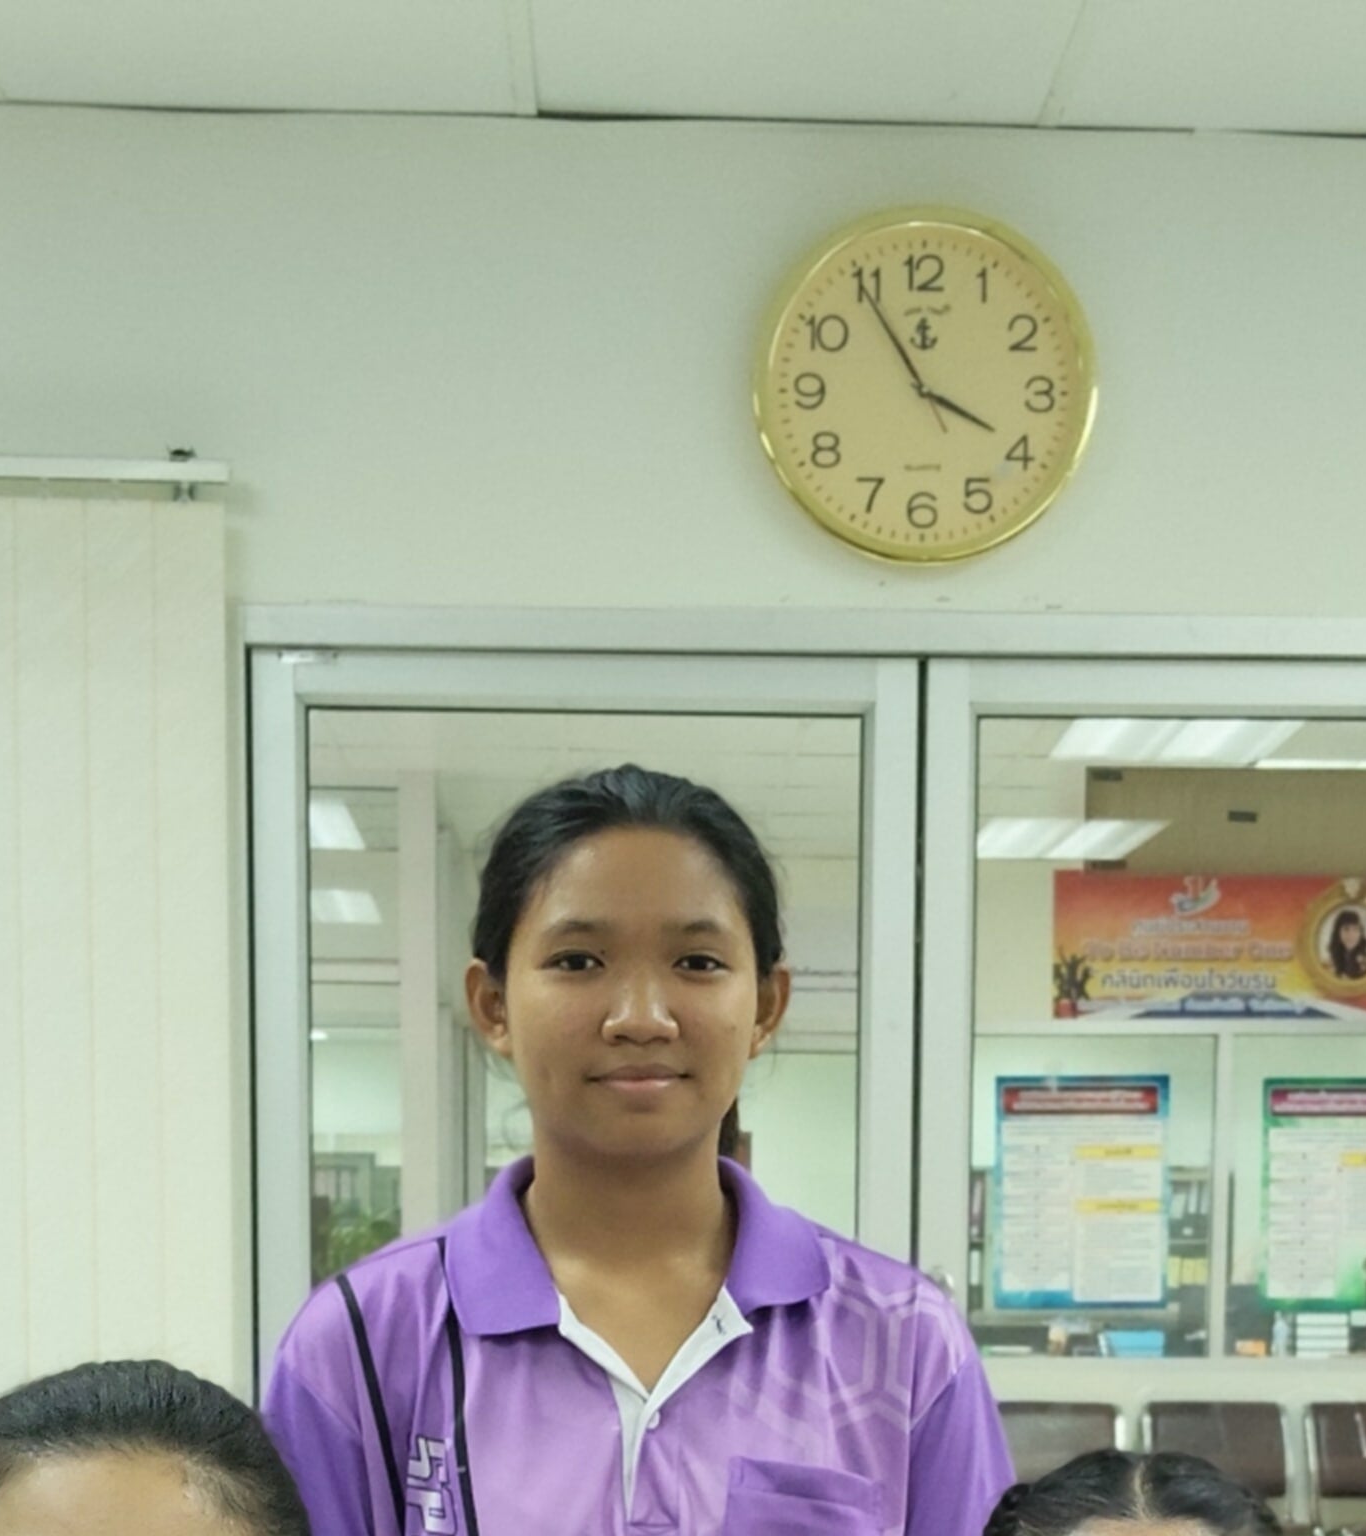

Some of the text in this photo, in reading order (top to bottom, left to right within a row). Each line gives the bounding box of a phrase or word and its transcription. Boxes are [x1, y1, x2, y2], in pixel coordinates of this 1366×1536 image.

[852, 267, 881, 304] 11
[903, 254, 944, 292] 12
[976, 267, 988, 304] 1
[805, 314, 849, 352] 10
[1008, 314, 1038, 352] 2
[793, 373, 825, 409] 9
[1024, 376, 1055, 413] 3
[811, 431, 841, 468] 8
[1005, 435, 1034, 471] 4
[856, 477, 885, 514] 7
[907, 492, 938, 529] 6
[963, 477, 993, 514] 5
